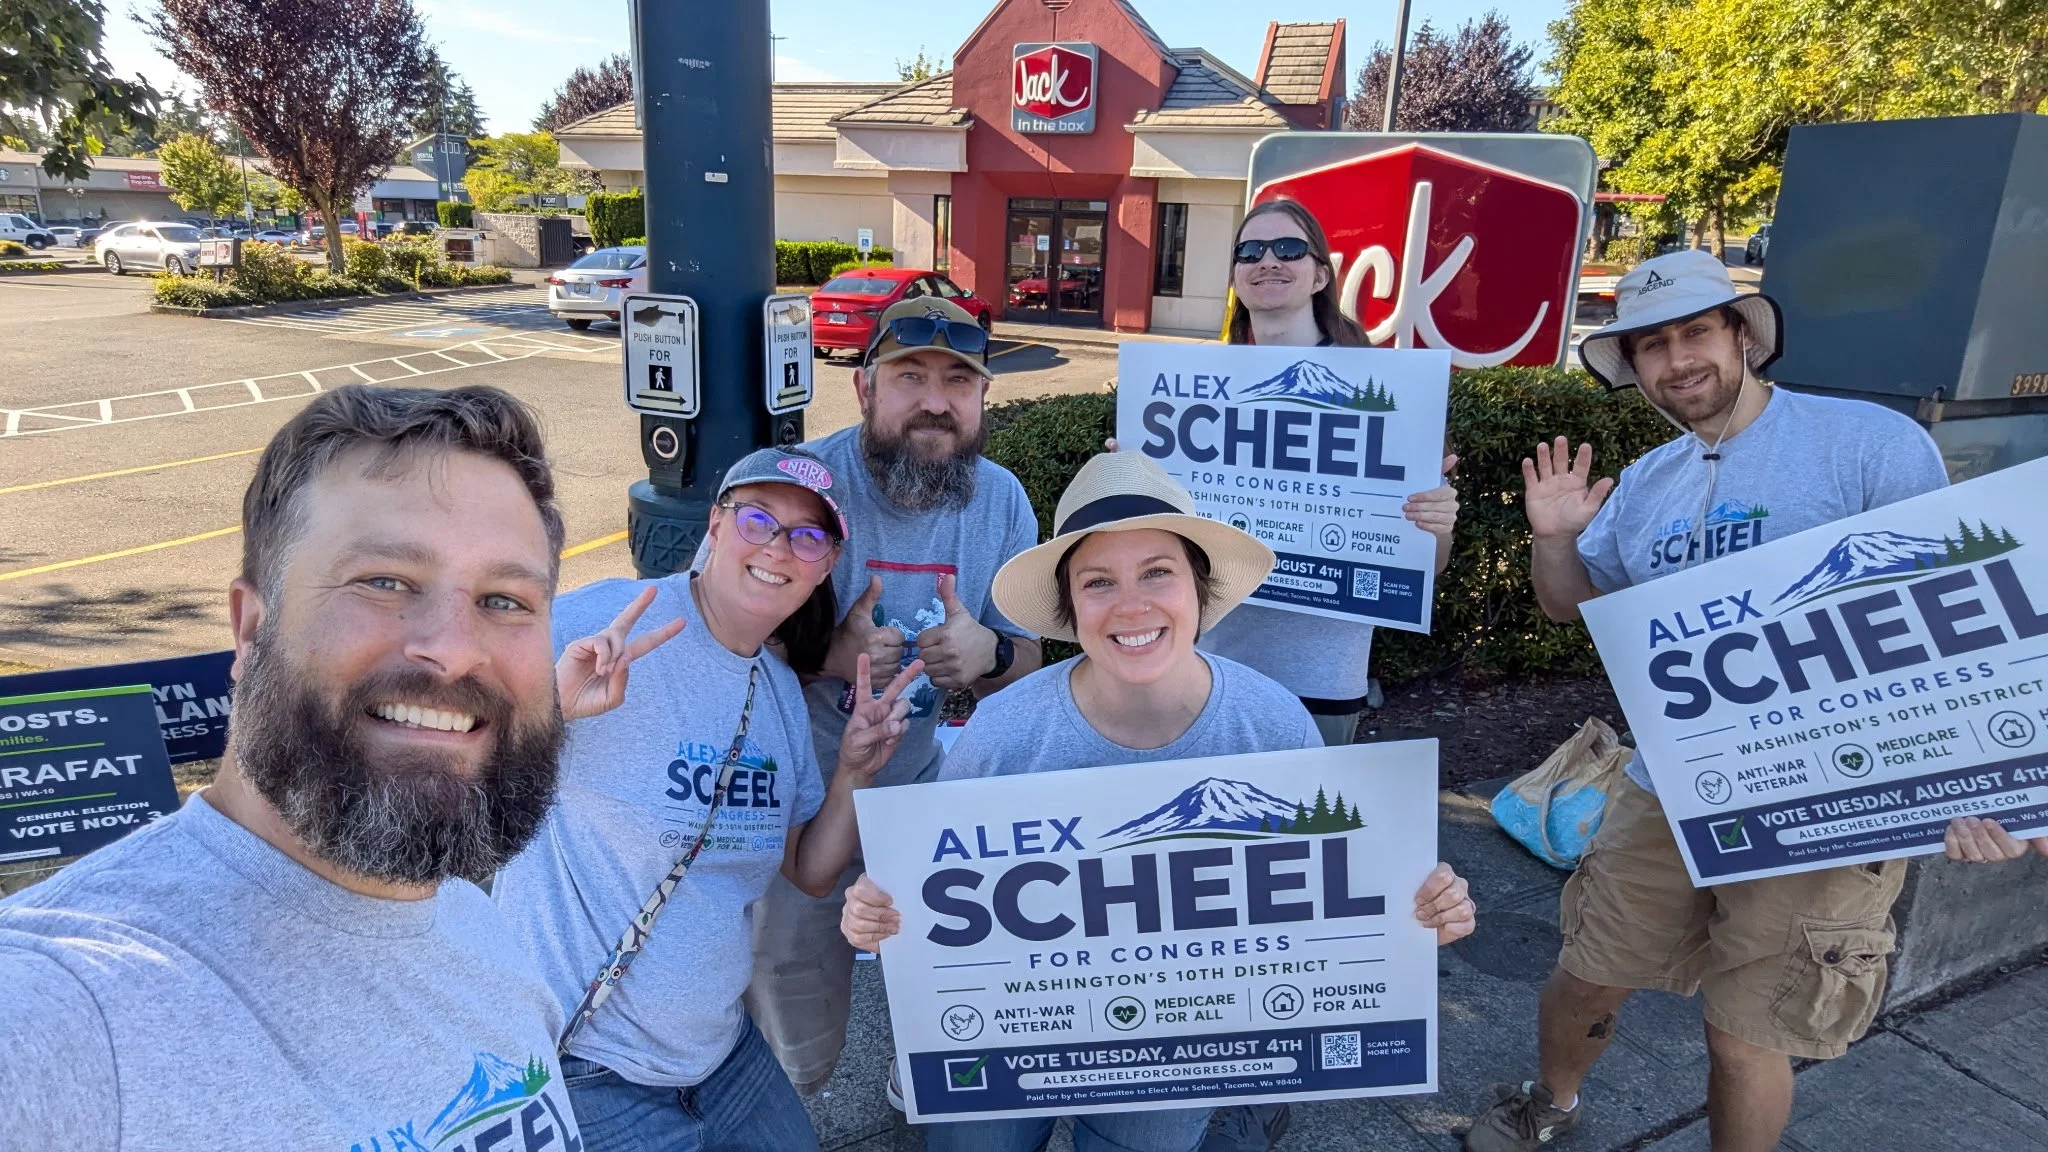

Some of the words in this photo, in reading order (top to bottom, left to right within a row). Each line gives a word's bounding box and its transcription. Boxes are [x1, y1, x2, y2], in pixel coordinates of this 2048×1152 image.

[1015, 54, 1088, 107] Jack
[1018, 119, 1030, 131] in
[1033, 119, 1056, 131] the
[1059, 120, 1085, 131] box
[633, 332, 652, 342] PUSH
[654, 334, 681, 345] BUTTON
[777, 333, 790, 343] PUSH
[790, 331, 807, 341] BUTTON
[649, 349, 671, 362] FOR
[784, 348, 798, 359] FOR
[1151, 372, 1231, 400] ALEX
[1141, 401, 1406, 481] SCHEEL
[787, 460, 826, 482] NHRA
[1191, 471, 1225, 486] FOR
[1236, 475, 1341, 497] CONGRESS
[1189, 491, 1265, 507] SHINGTON'S
[1271, 499, 1299, 511] 10TH
[1304, 503, 1364, 519] DISTRICT
[1256, 518, 1304, 532] MEDICARE
[1655, 517, 1691, 538] ALEX
[1255, 530, 1274, 540] FOR
[1278, 533, 1295, 543] ALL
[1351, 530, 1400, 544] HOUSING
[1351, 542, 1372, 553] FOR
[1376, 545, 1395, 556] ALL
[1274, 559, 1315, 575] UGUST
[1319, 565, 1343, 579] 4TH
[1383, 581, 1398, 589] SCAN
[1383, 588, 1398, 596] MORE
[1649, 589, 1764, 649] ALEX
[1648, 558, 2048, 720] SCHEEL
[152, 682, 197, 702] YN
[1749, 706, 1804, 730] FOR
[1818, 662, 1995, 713] CONGRESS
[1736, 715, 1880, 756] WASHINGTON'S
[1887, 702, 1937, 723] 10TH
[1944, 679, 2044, 711] DISTRICT
[1876, 727, 1960, 753] MEDICARE
[1882, 753, 1917, 767] FOR
[1922, 745, 1953, 760] ALL
[0, 754, 143, 788] RAFAT
[1737, 758, 1807, 782] ANTI-WAR
[20, 788, 55, 797] WA-10
[665, 759, 780, 808] SCEEL
[1744, 773, 1808, 794] VETERAN
[1757, 806, 1811, 828] VOTE
[1811, 788, 1910, 819] TUESDAY,
[1915, 772, 2004, 802] AUGUST
[2012, 765, 2048, 783] 4TH
[16, 809, 79, 823] GENERAL
[82, 801, 150, 815] ELECTION
[714, 811, 766, 821] NGRESS
[1799, 792, 2030, 839] ALEXSCHEELFORCONGRESS.COM
[9, 821, 76, 839] VOTE
[83, 813, 140, 830] NOV.
[1788, 849, 1806, 858] Paid
[1806, 847, 1818, 855] for
[1819, 845, 1830, 853] by
[1831, 842, 1845, 850] the
[1846, 837, 1890, 848] Committee
[1902, 830, 1924, 840] Elect
[1926, 828, 1945, 836] Alex
[1998, 816, 2019, 824] oma,
[2020, 812, 2037, 821] Wa
[932, 816, 1086, 862] ALEX
[921, 836, 1386, 947] SCHEEL
[1029, 951, 1091, 969] FOR
[1111, 935, 1290, 963] CONGRESS
[1004, 972, 1167, 993] WASHINGTON'S
[1176, 967, 1224, 982] 10TH
[1235, 959, 1328, 978] DISTRICT
[1154, 993, 1236, 1009] MEDICARE
[1313, 982, 1387, 998] HOUSING
[994, 1004, 1075, 1021] ANTI-WAR
[1155, 1011, 1187, 1024] FOR
[1194, 1009, 1223, 1021] ALL
[1313, 1000, 1345, 1013] FOR
[1351, 998, 1381, 1010] ALL
[999, 1019, 1073, 1034] VETERAN
[1004, 1053, 1061, 1069] VOTE
[1066, 1046, 1168, 1067] TUESDAY,
[1172, 1040, 1260, 1060] AUGUST
[1266, 1038, 1303, 1053] 4TH
[1367, 1048, 1390, 1056] MORE
[1390, 1039, 1406, 1047] FOR
[1043, 1061, 1274, 1085] ALEXSCHEELFORCONGRESS.COM
[1026, 1093, 1045, 1101] Paid
[1046, 1092, 1059, 1100] for
[1060, 1092, 1072, 1100] by
[1074, 1091, 1088, 1099] the
[1089, 1088, 1135, 1098] Committee
[1148, 1086, 1169, 1094] Elect
[1191, 1083, 1222, 1092] Scheel,
[1223, 1081, 1257, 1089] Tacoma,
[1275, 1078, 1302, 1086] 98404
